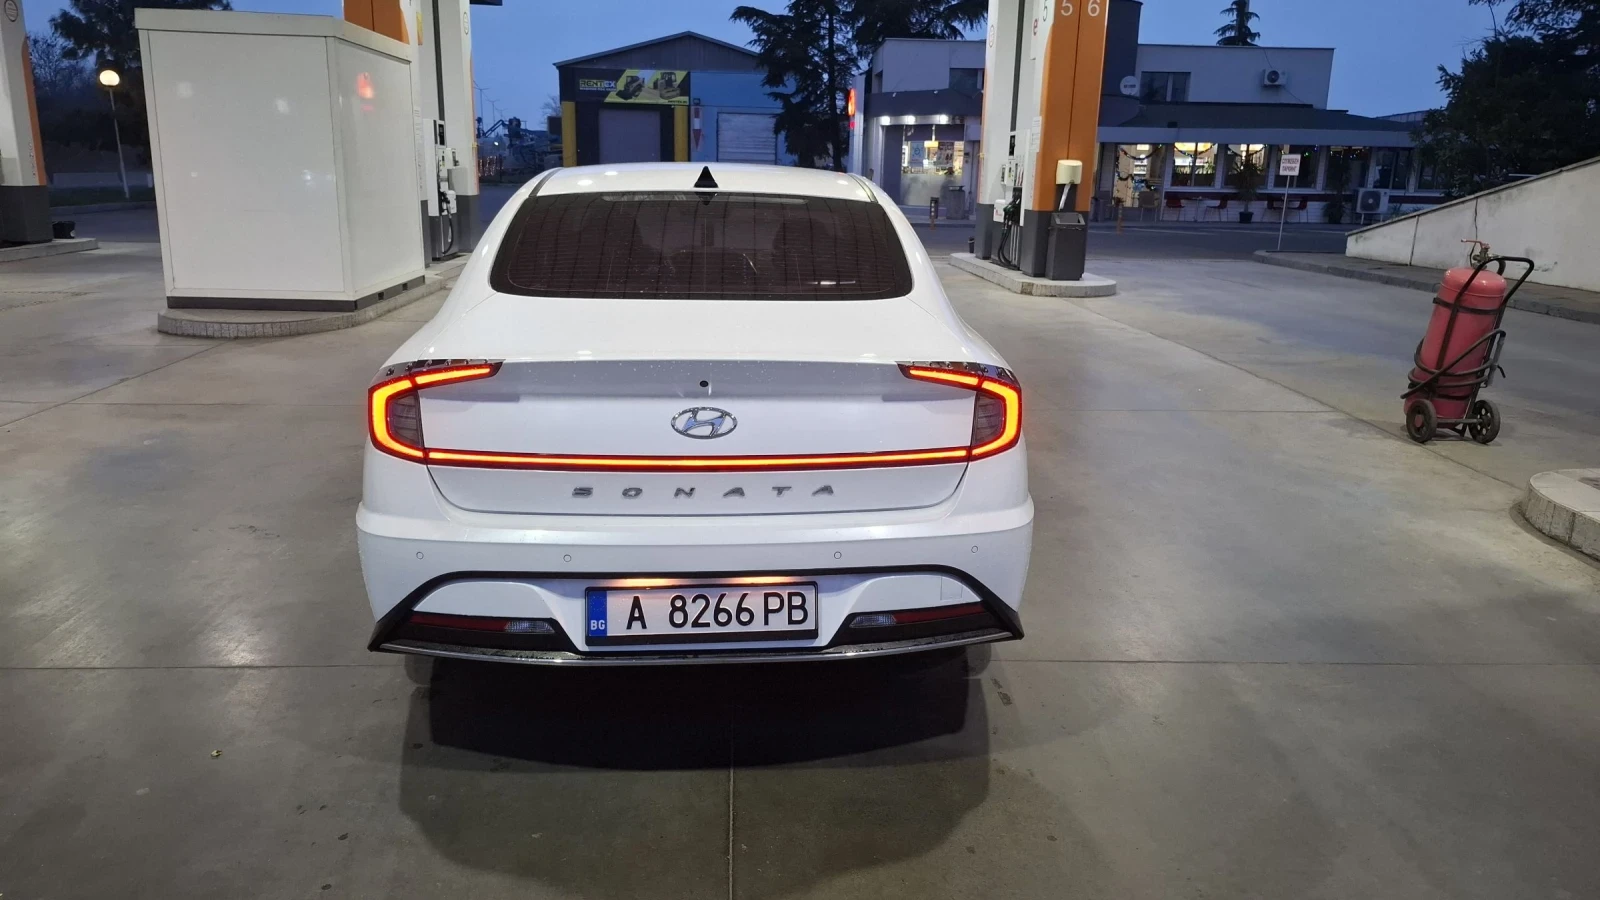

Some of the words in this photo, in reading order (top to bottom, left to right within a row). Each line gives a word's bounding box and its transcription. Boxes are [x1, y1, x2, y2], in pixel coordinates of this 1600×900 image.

[1060, 0, 1073, 16] 5
[1087, 0, 1100, 17] 6
[579, 79, 616, 88] RENTEX
[571, 485, 835, 498] SONATA
[626, 595, 648, 630] A
[590, 619, 606, 631] BG
